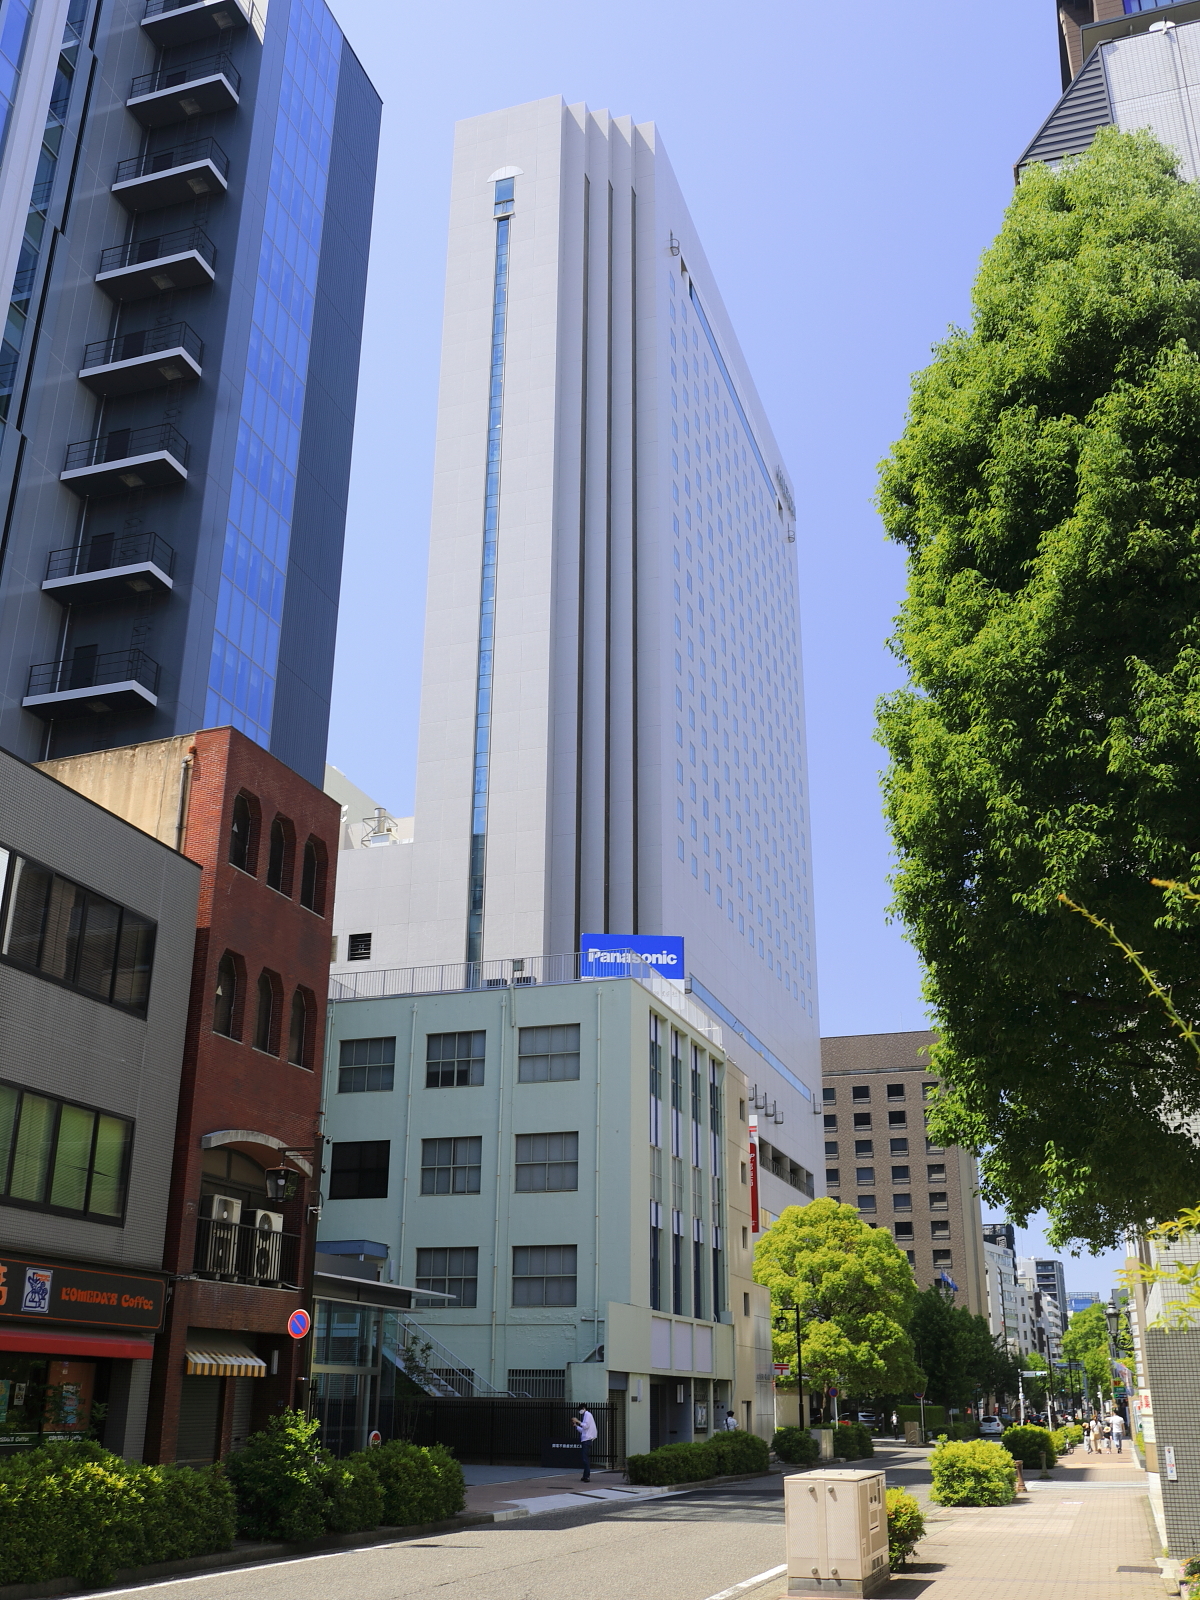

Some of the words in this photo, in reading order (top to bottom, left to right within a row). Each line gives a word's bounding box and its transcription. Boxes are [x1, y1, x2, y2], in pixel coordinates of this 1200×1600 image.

[588, 948, 677, 965] Panasonic
[61, 1287, 118, 1305] KOMEDA'S
[121, 1294, 153, 1310] Coffee
